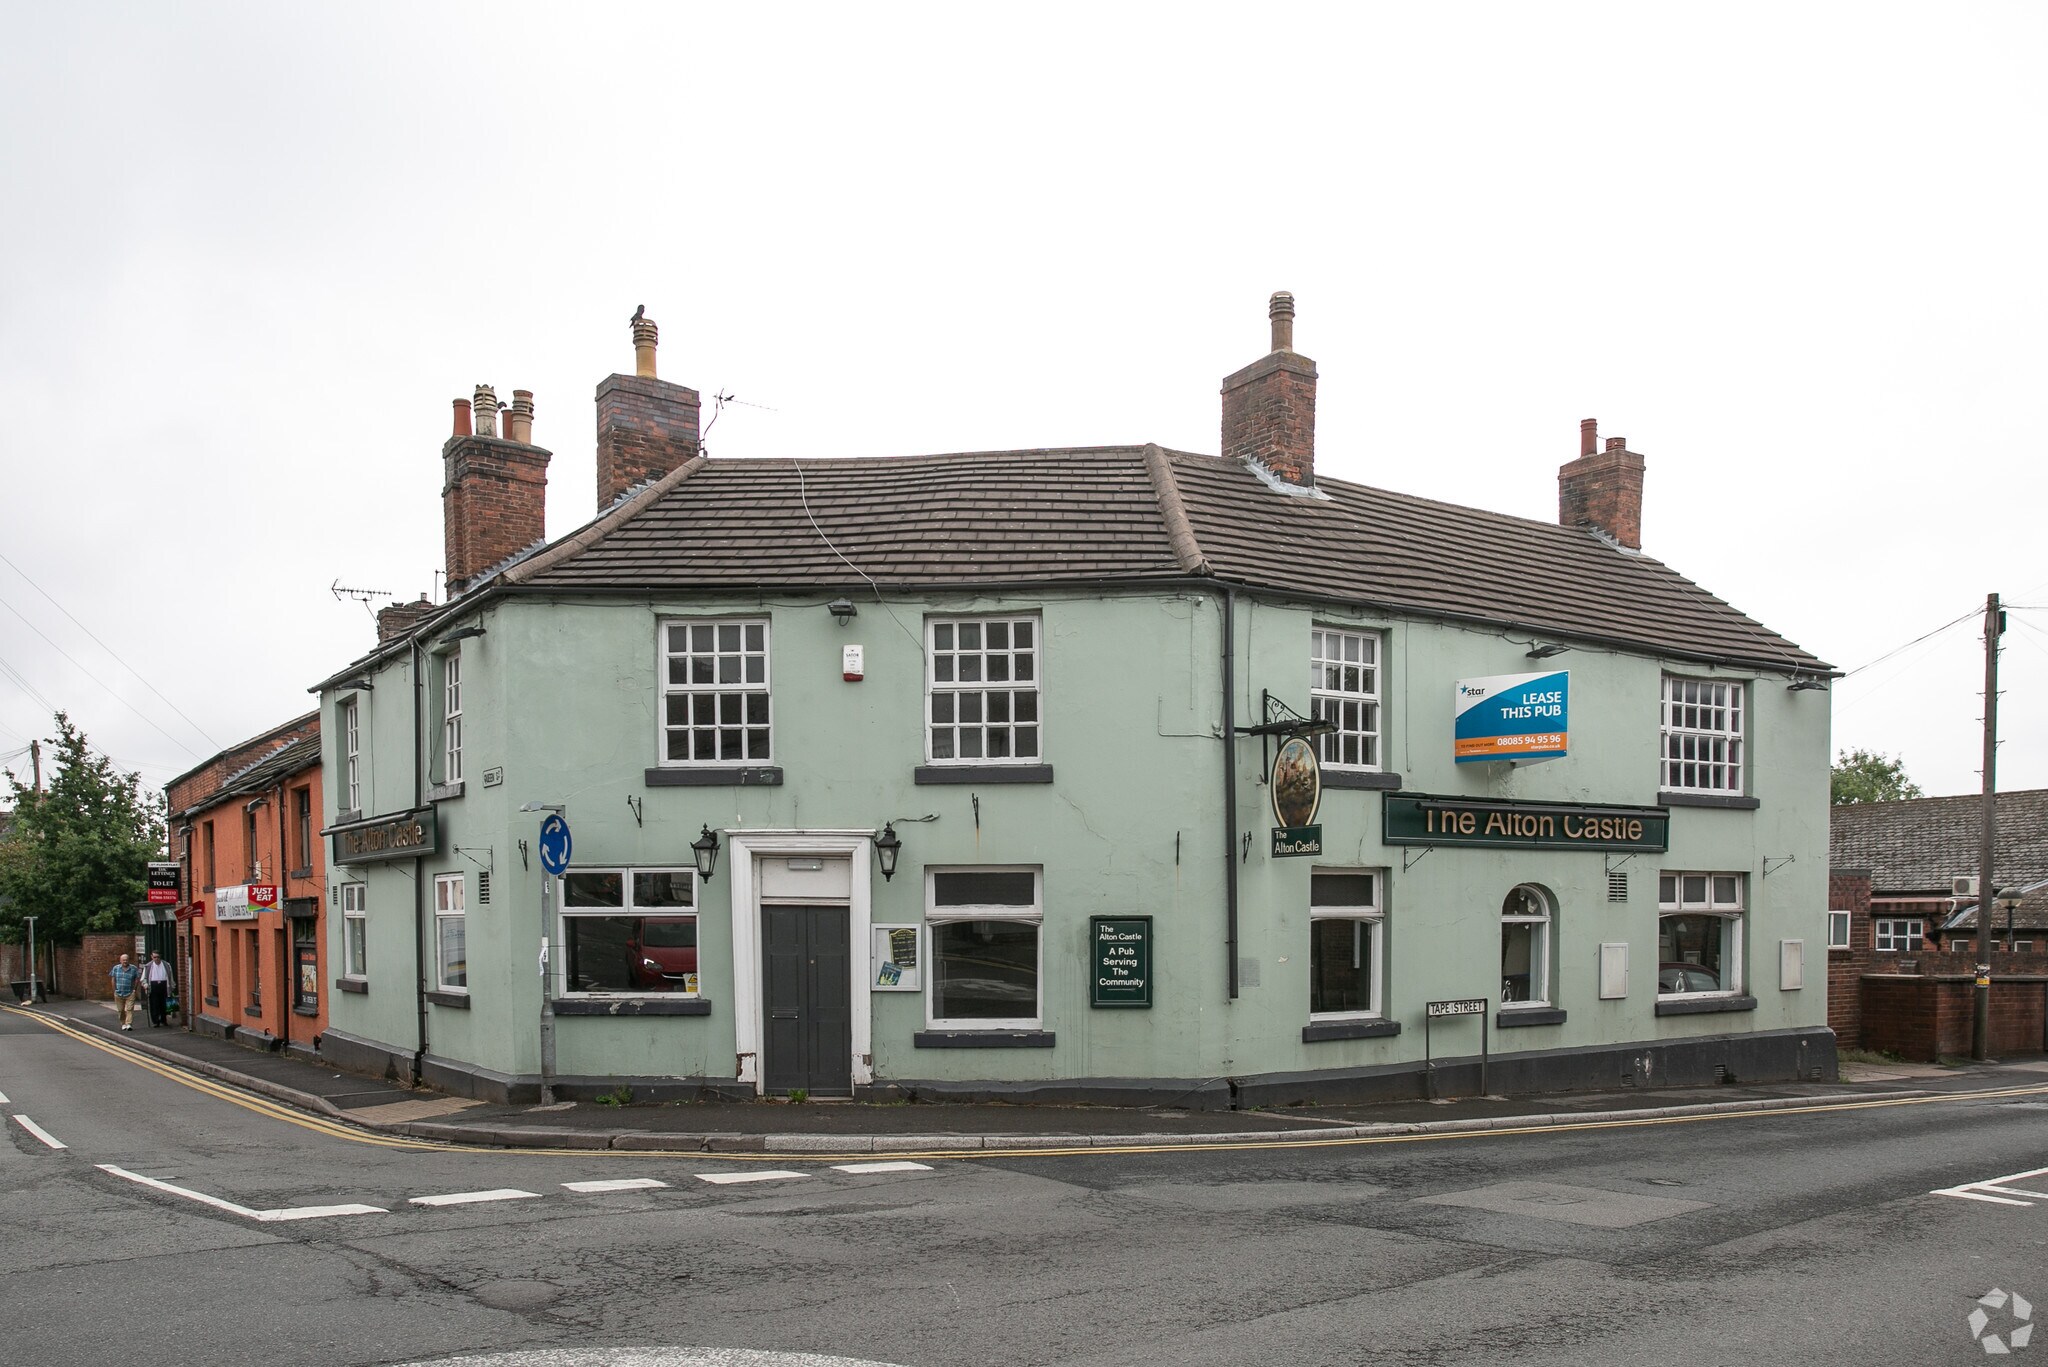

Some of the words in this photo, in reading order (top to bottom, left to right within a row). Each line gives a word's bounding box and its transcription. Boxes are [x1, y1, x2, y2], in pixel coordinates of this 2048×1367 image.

[1467, 687, 1485, 696] star
[1523, 691, 1562, 705] LEASE
[1501, 706, 1531, 719] THIS
[1535, 705, 1562, 717] PUB
[1497, 736, 1523, 746] 08085
[1525, 736, 1535, 744] 94
[1537, 735, 1548, 743] 95
[1549, 734, 1561, 743] 96
[1485, 812, 1554, 837] Alton
[1564, 816, 1643, 841] Castle
[389, 819, 422, 848] Castle
[1275, 831, 1287, 839] The
[1275, 842, 1294, 854] Alton
[1295, 840, 1319, 852] Castle
[252, 887, 273, 895] JUST
[1100, 925, 1114, 933] The
[1118, 947, 1135, 955] Pub
[1103, 957, 1138, 967] Serving
[1112, 968, 1129, 976] The
[1099, 978, 1144, 988] Community
[1431, 1003, 1450, 1014] TAPE
[1454, 1001, 1482, 1013] STREET
